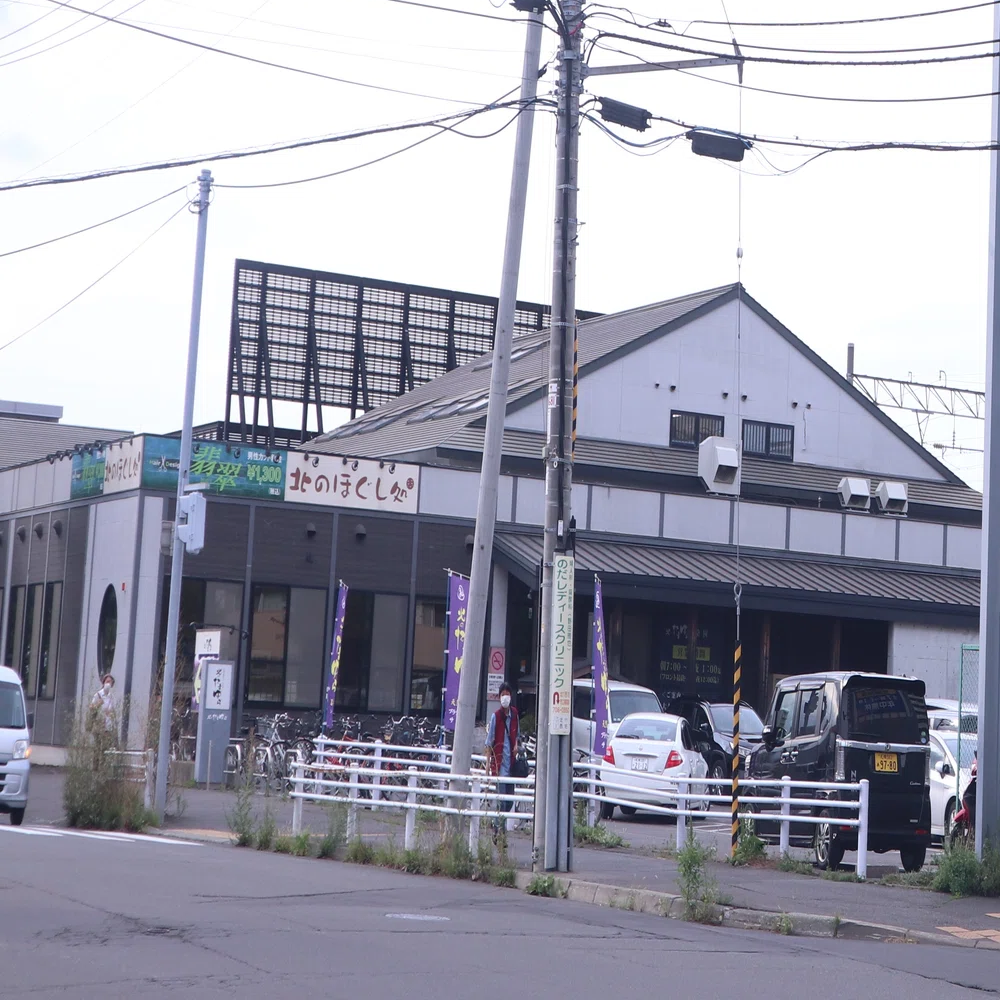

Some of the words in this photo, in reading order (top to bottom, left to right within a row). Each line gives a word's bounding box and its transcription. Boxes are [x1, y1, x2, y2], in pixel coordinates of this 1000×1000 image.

[165, 461, 181, 470] Desig
[289, 466, 408, 503] 北のほぐし処
[554, 559, 569, 689] のだレディースクリニック
